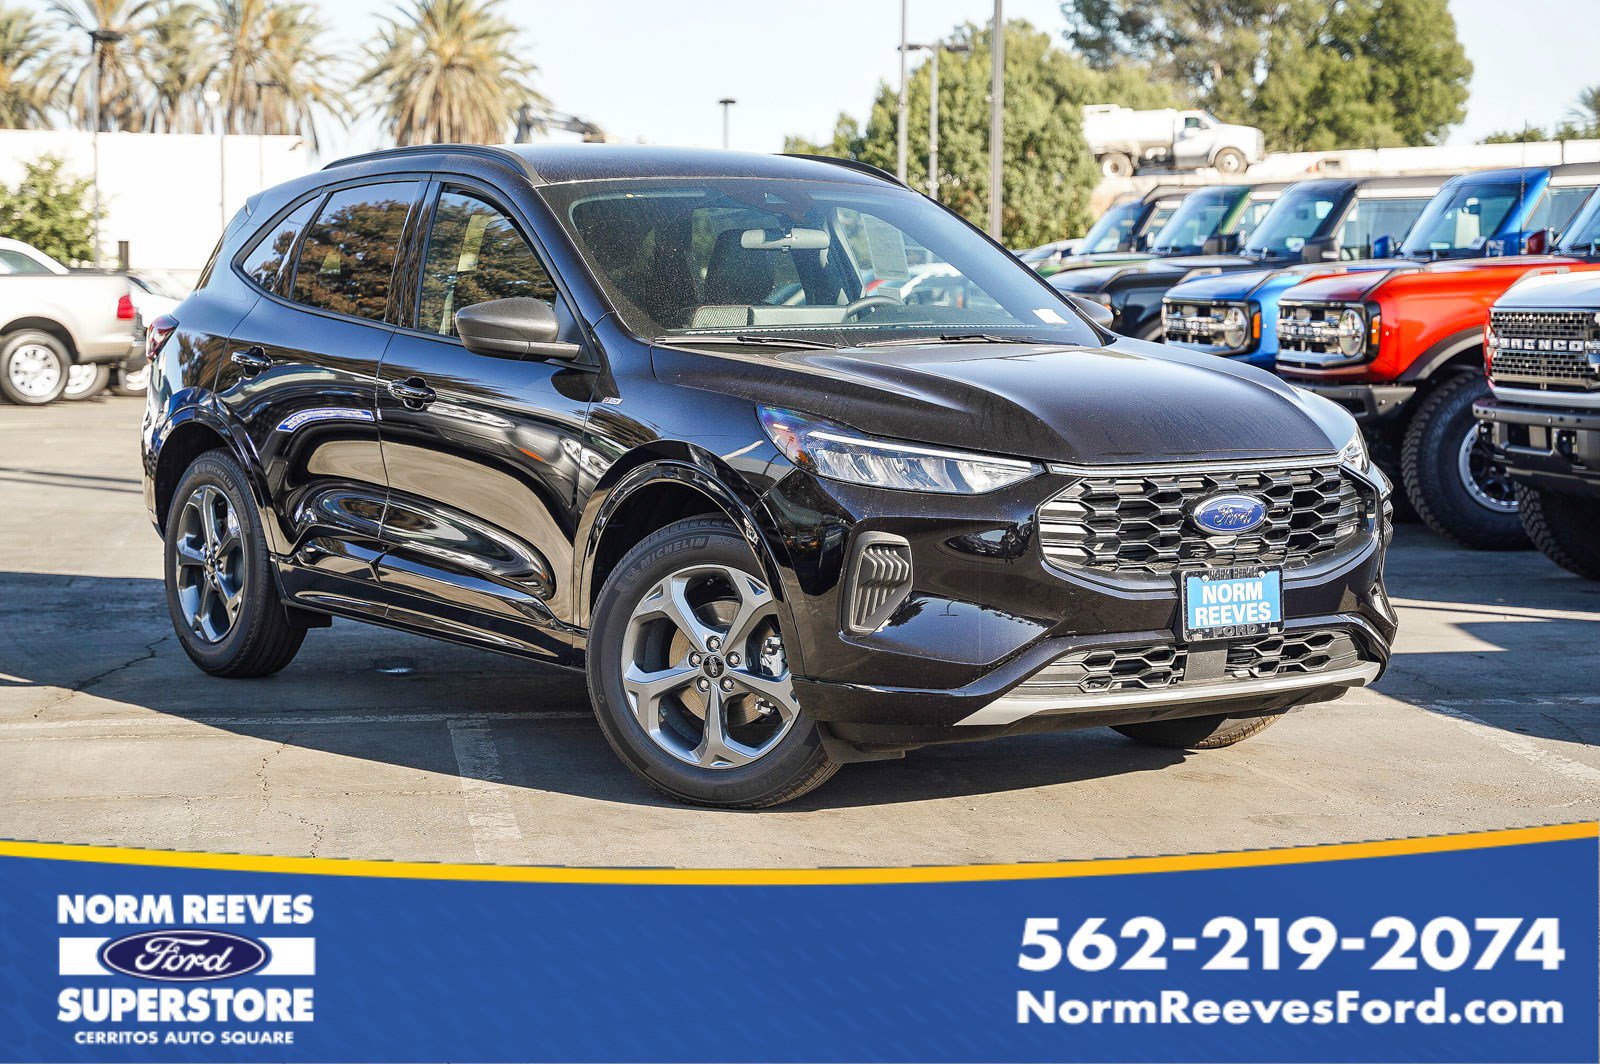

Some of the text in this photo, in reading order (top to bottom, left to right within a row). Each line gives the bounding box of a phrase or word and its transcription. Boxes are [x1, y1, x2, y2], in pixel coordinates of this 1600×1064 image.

[1499, 338, 1585, 351] BRONCO
[206, 464, 235, 489] MICHELIN
[640, 536, 706, 570] MICHELIN
[1202, 581, 1263, 605] NORM
[1194, 601, 1272, 627] REEVES
[1213, 623, 1258, 639] FORD
